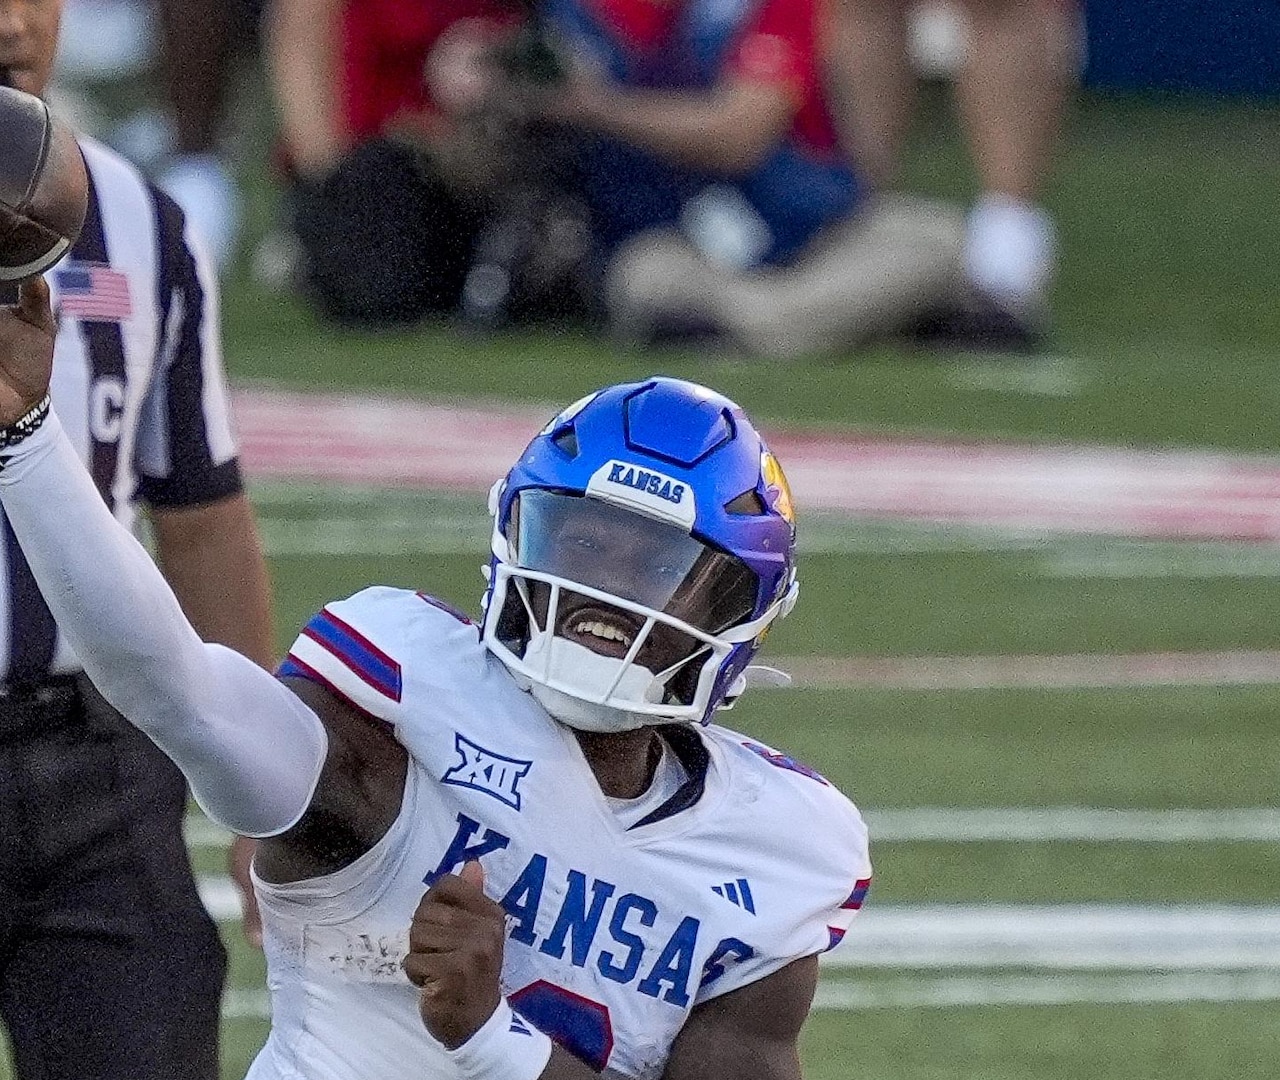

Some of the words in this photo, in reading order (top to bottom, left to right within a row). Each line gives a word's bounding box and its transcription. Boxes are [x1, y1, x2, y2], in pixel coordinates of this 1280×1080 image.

[90, 381, 124, 442] C
[607, 463, 684, 504] KANSAS
[422, 812, 754, 1009] KANSAS
